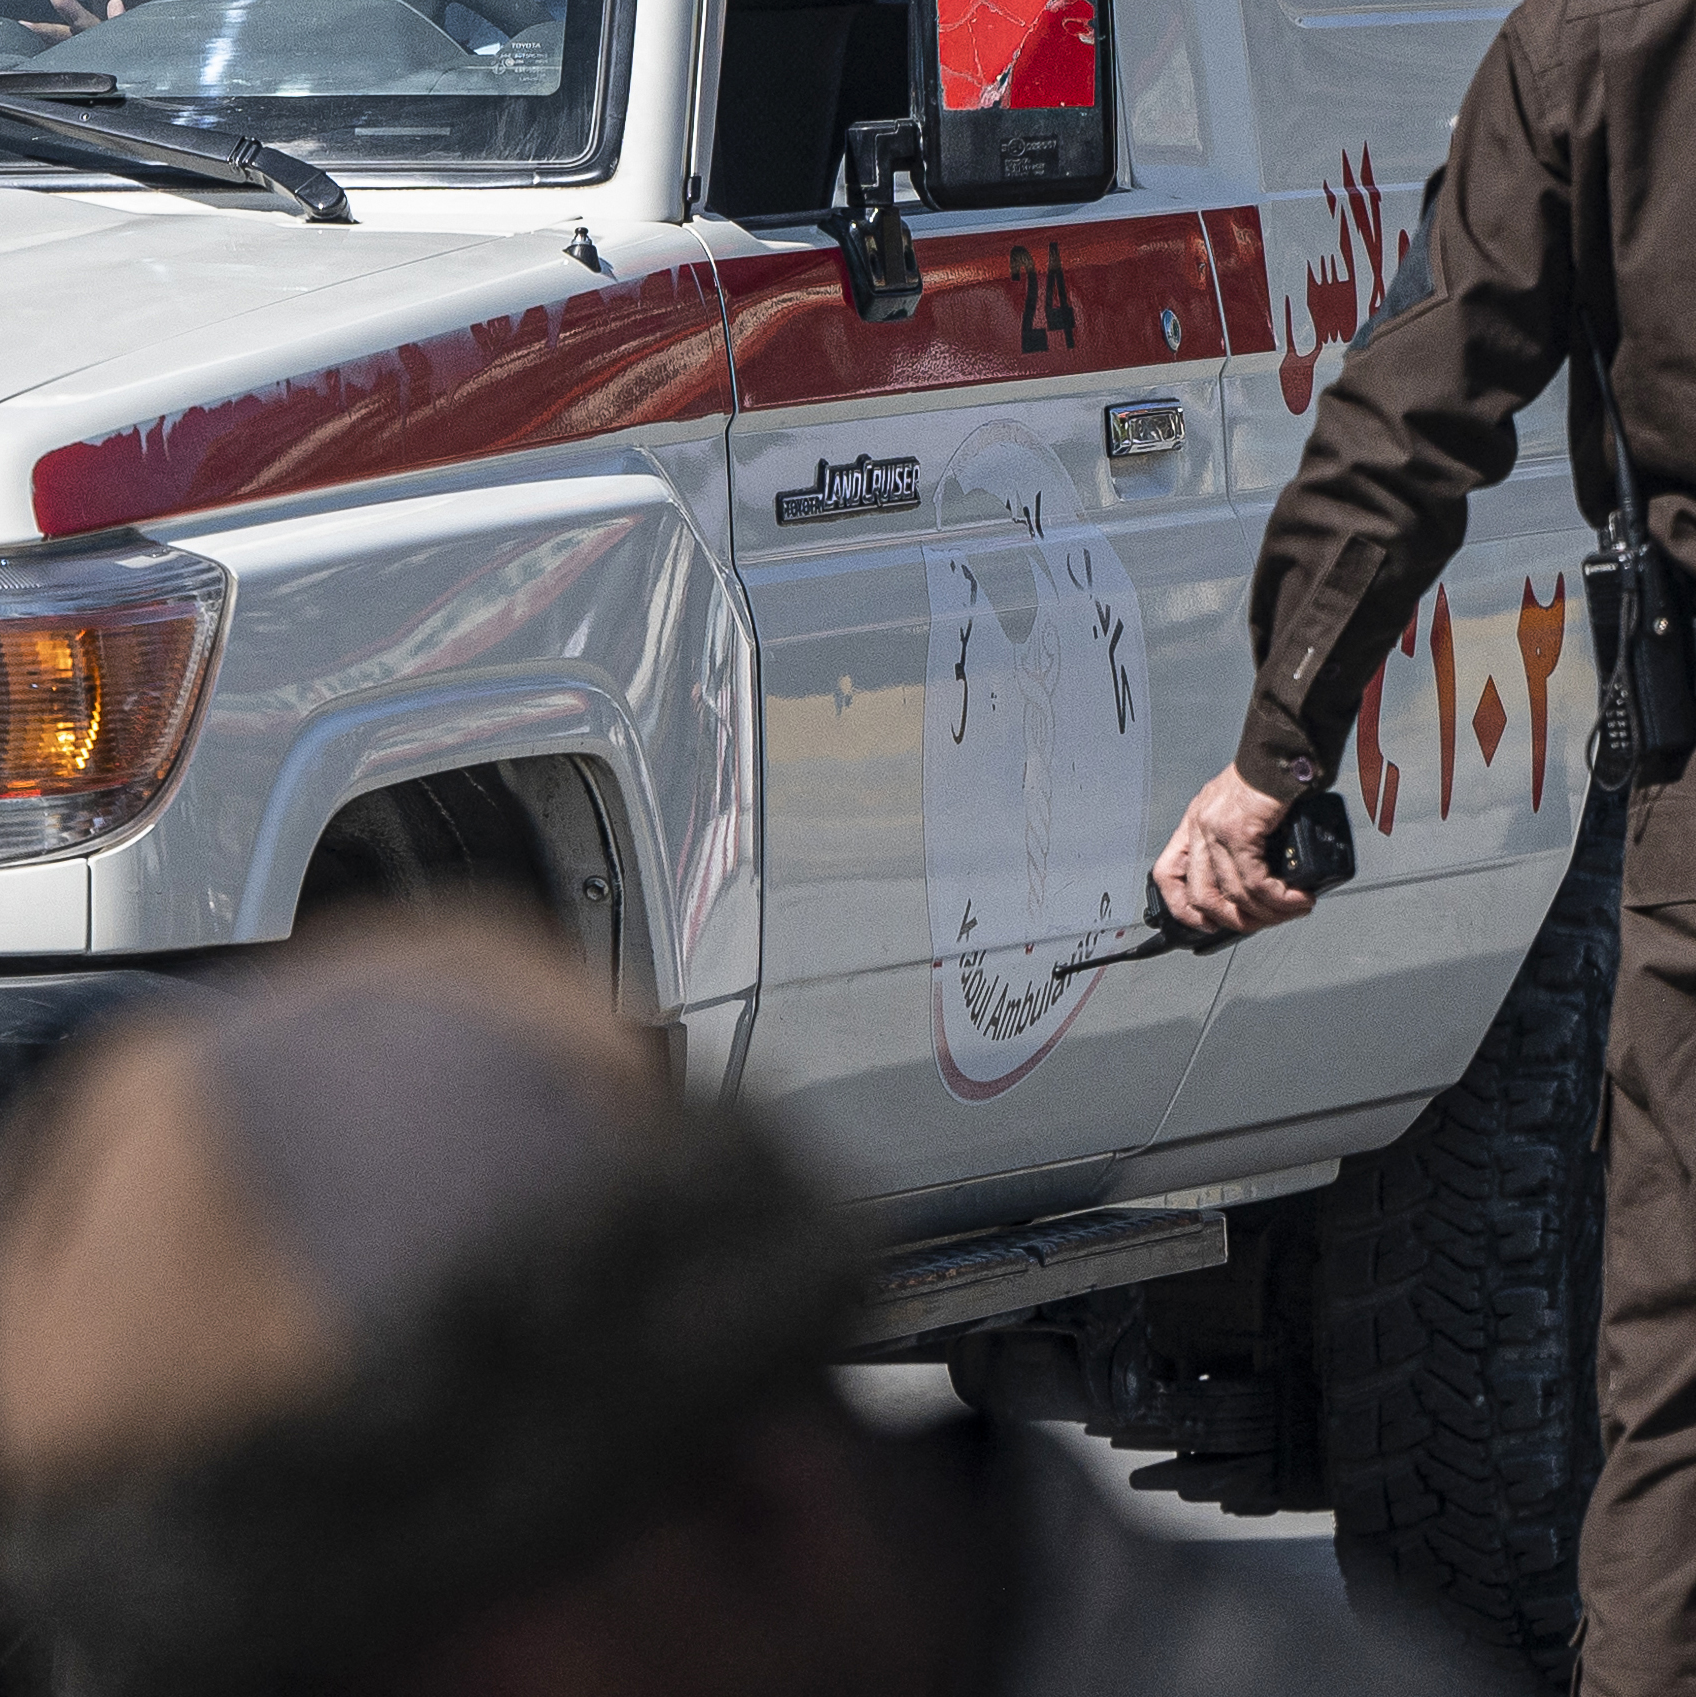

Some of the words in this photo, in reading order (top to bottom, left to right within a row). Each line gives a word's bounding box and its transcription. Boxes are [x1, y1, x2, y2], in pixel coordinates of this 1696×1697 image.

[511, 42, 542, 50] TOYOTA
[1009, 241, 1077, 354] 24
[783, 495, 825, 519] TOYOTA
